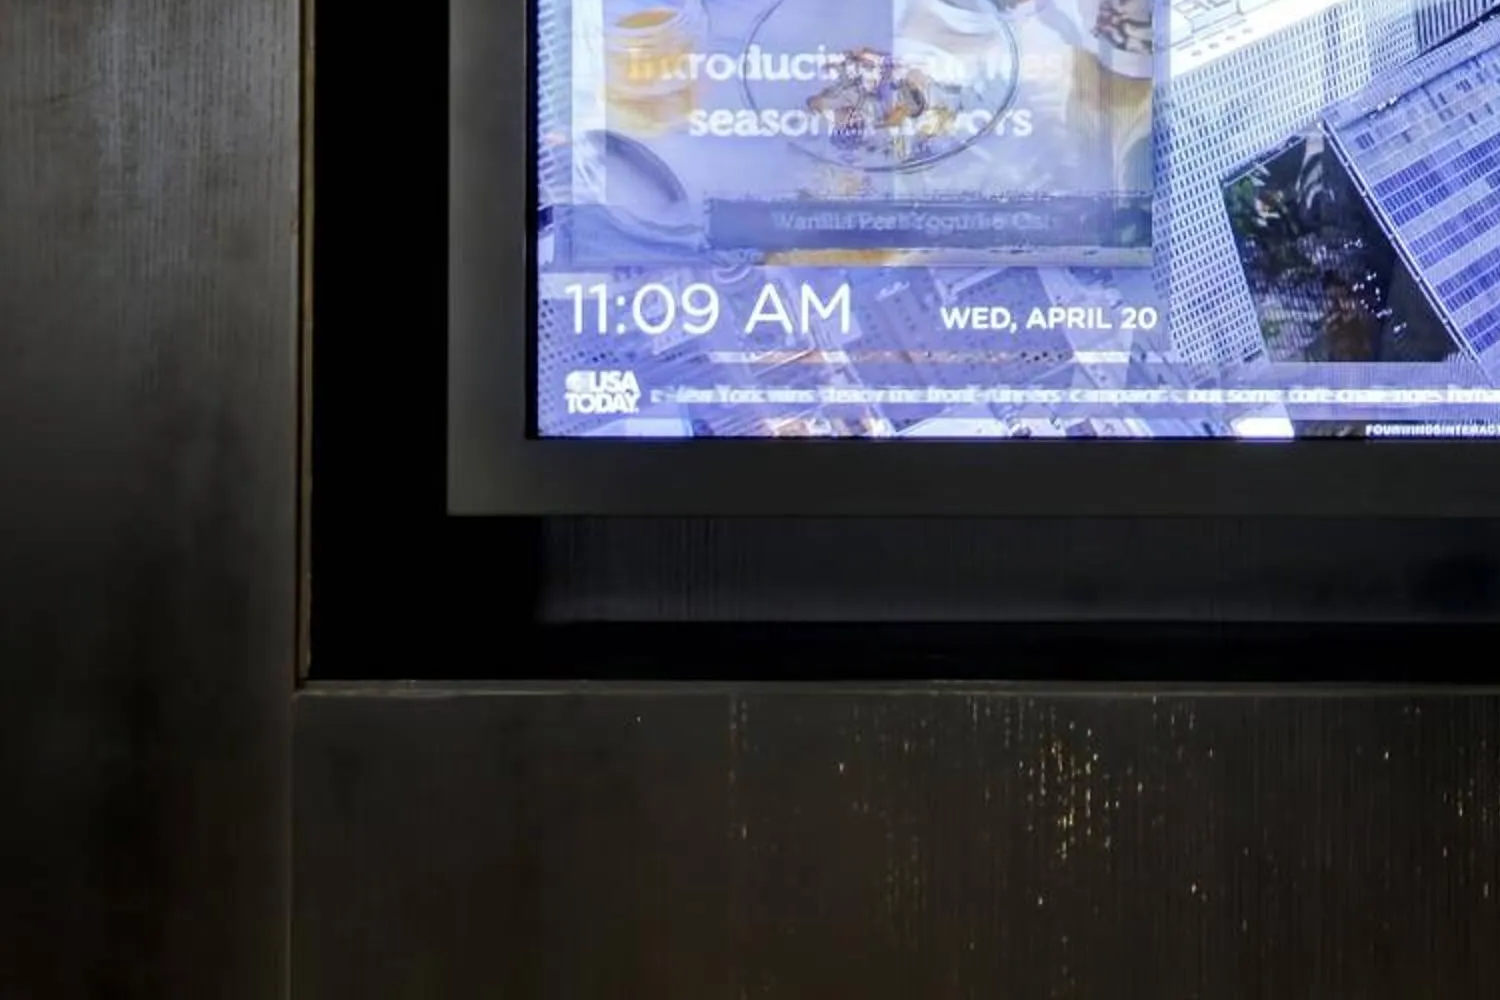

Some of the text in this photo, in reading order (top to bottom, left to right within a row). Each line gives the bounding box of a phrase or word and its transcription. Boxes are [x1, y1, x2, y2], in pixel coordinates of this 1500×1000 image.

[564, 283, 852, 335] 11:09 AM
[940, 308, 1157, 333] WED, APRIL 20
[588, 370, 639, 394] USA
